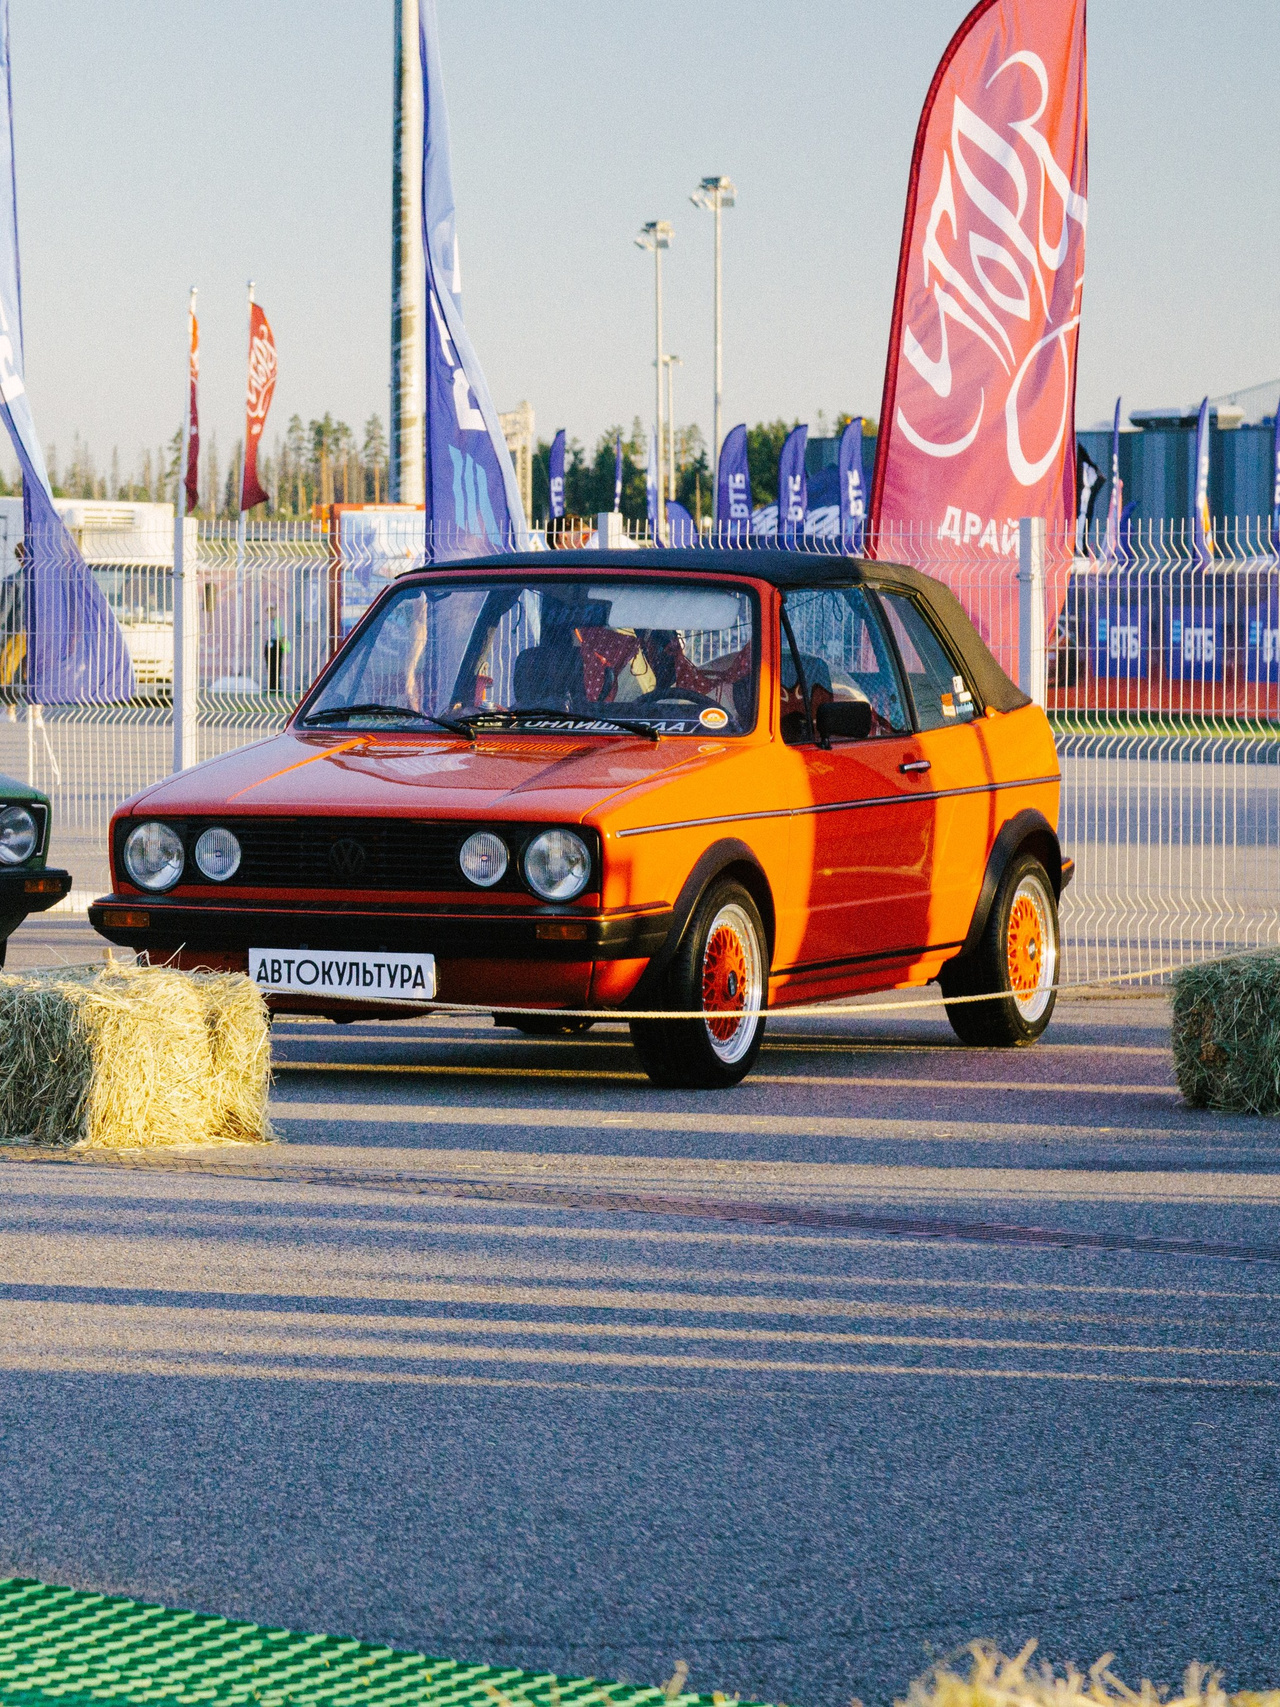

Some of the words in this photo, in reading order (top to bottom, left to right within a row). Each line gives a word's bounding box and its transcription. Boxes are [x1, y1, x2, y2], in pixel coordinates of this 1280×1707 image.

[728, 472, 750, 519] ВТБ
[1110, 626, 1140, 660] ВТБ
[1184, 627, 1214, 662] ВТБ
[256, 957, 426, 990] АВТОКУЛЬТУРА
